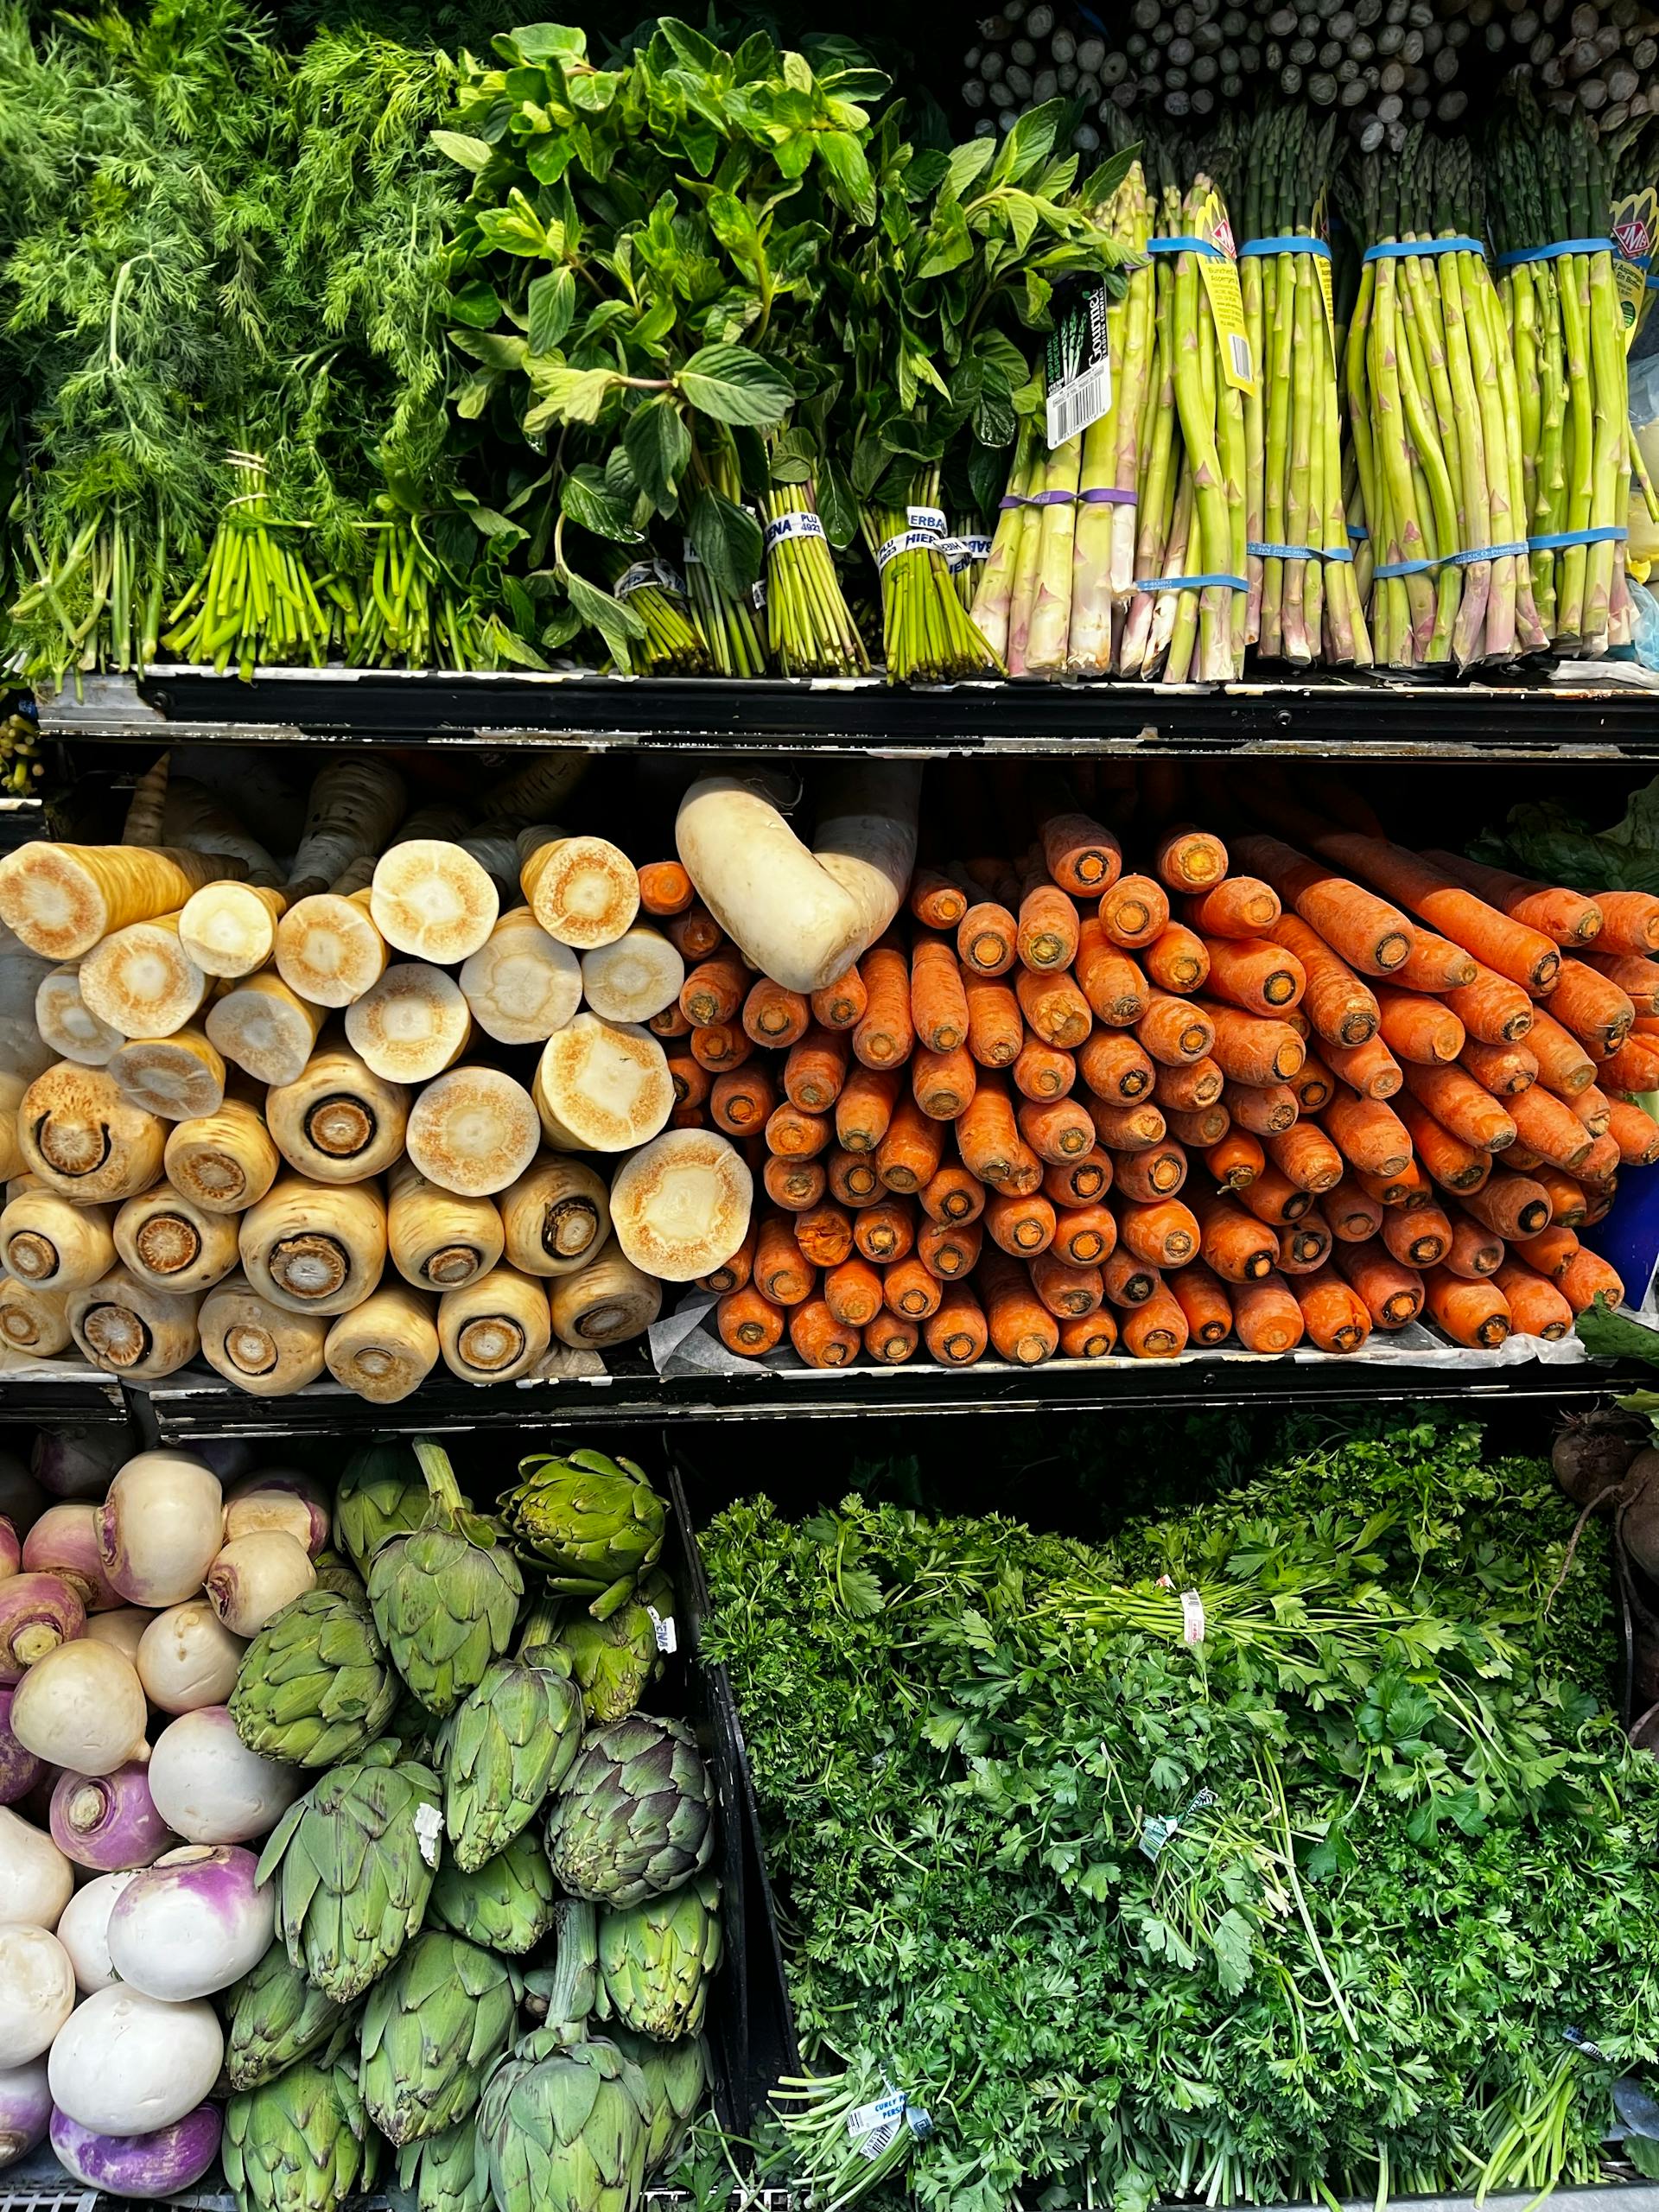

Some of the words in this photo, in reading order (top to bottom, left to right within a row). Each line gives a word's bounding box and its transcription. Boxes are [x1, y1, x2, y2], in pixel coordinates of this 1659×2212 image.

[1619, 226, 1647, 251] JMB
[1088, 289, 1103, 367] Gourmet
[800, 514, 817, 524] PLU
[875, 2099, 897, 2112] CURLY
[882, 2105, 904, 2120] PERSI
